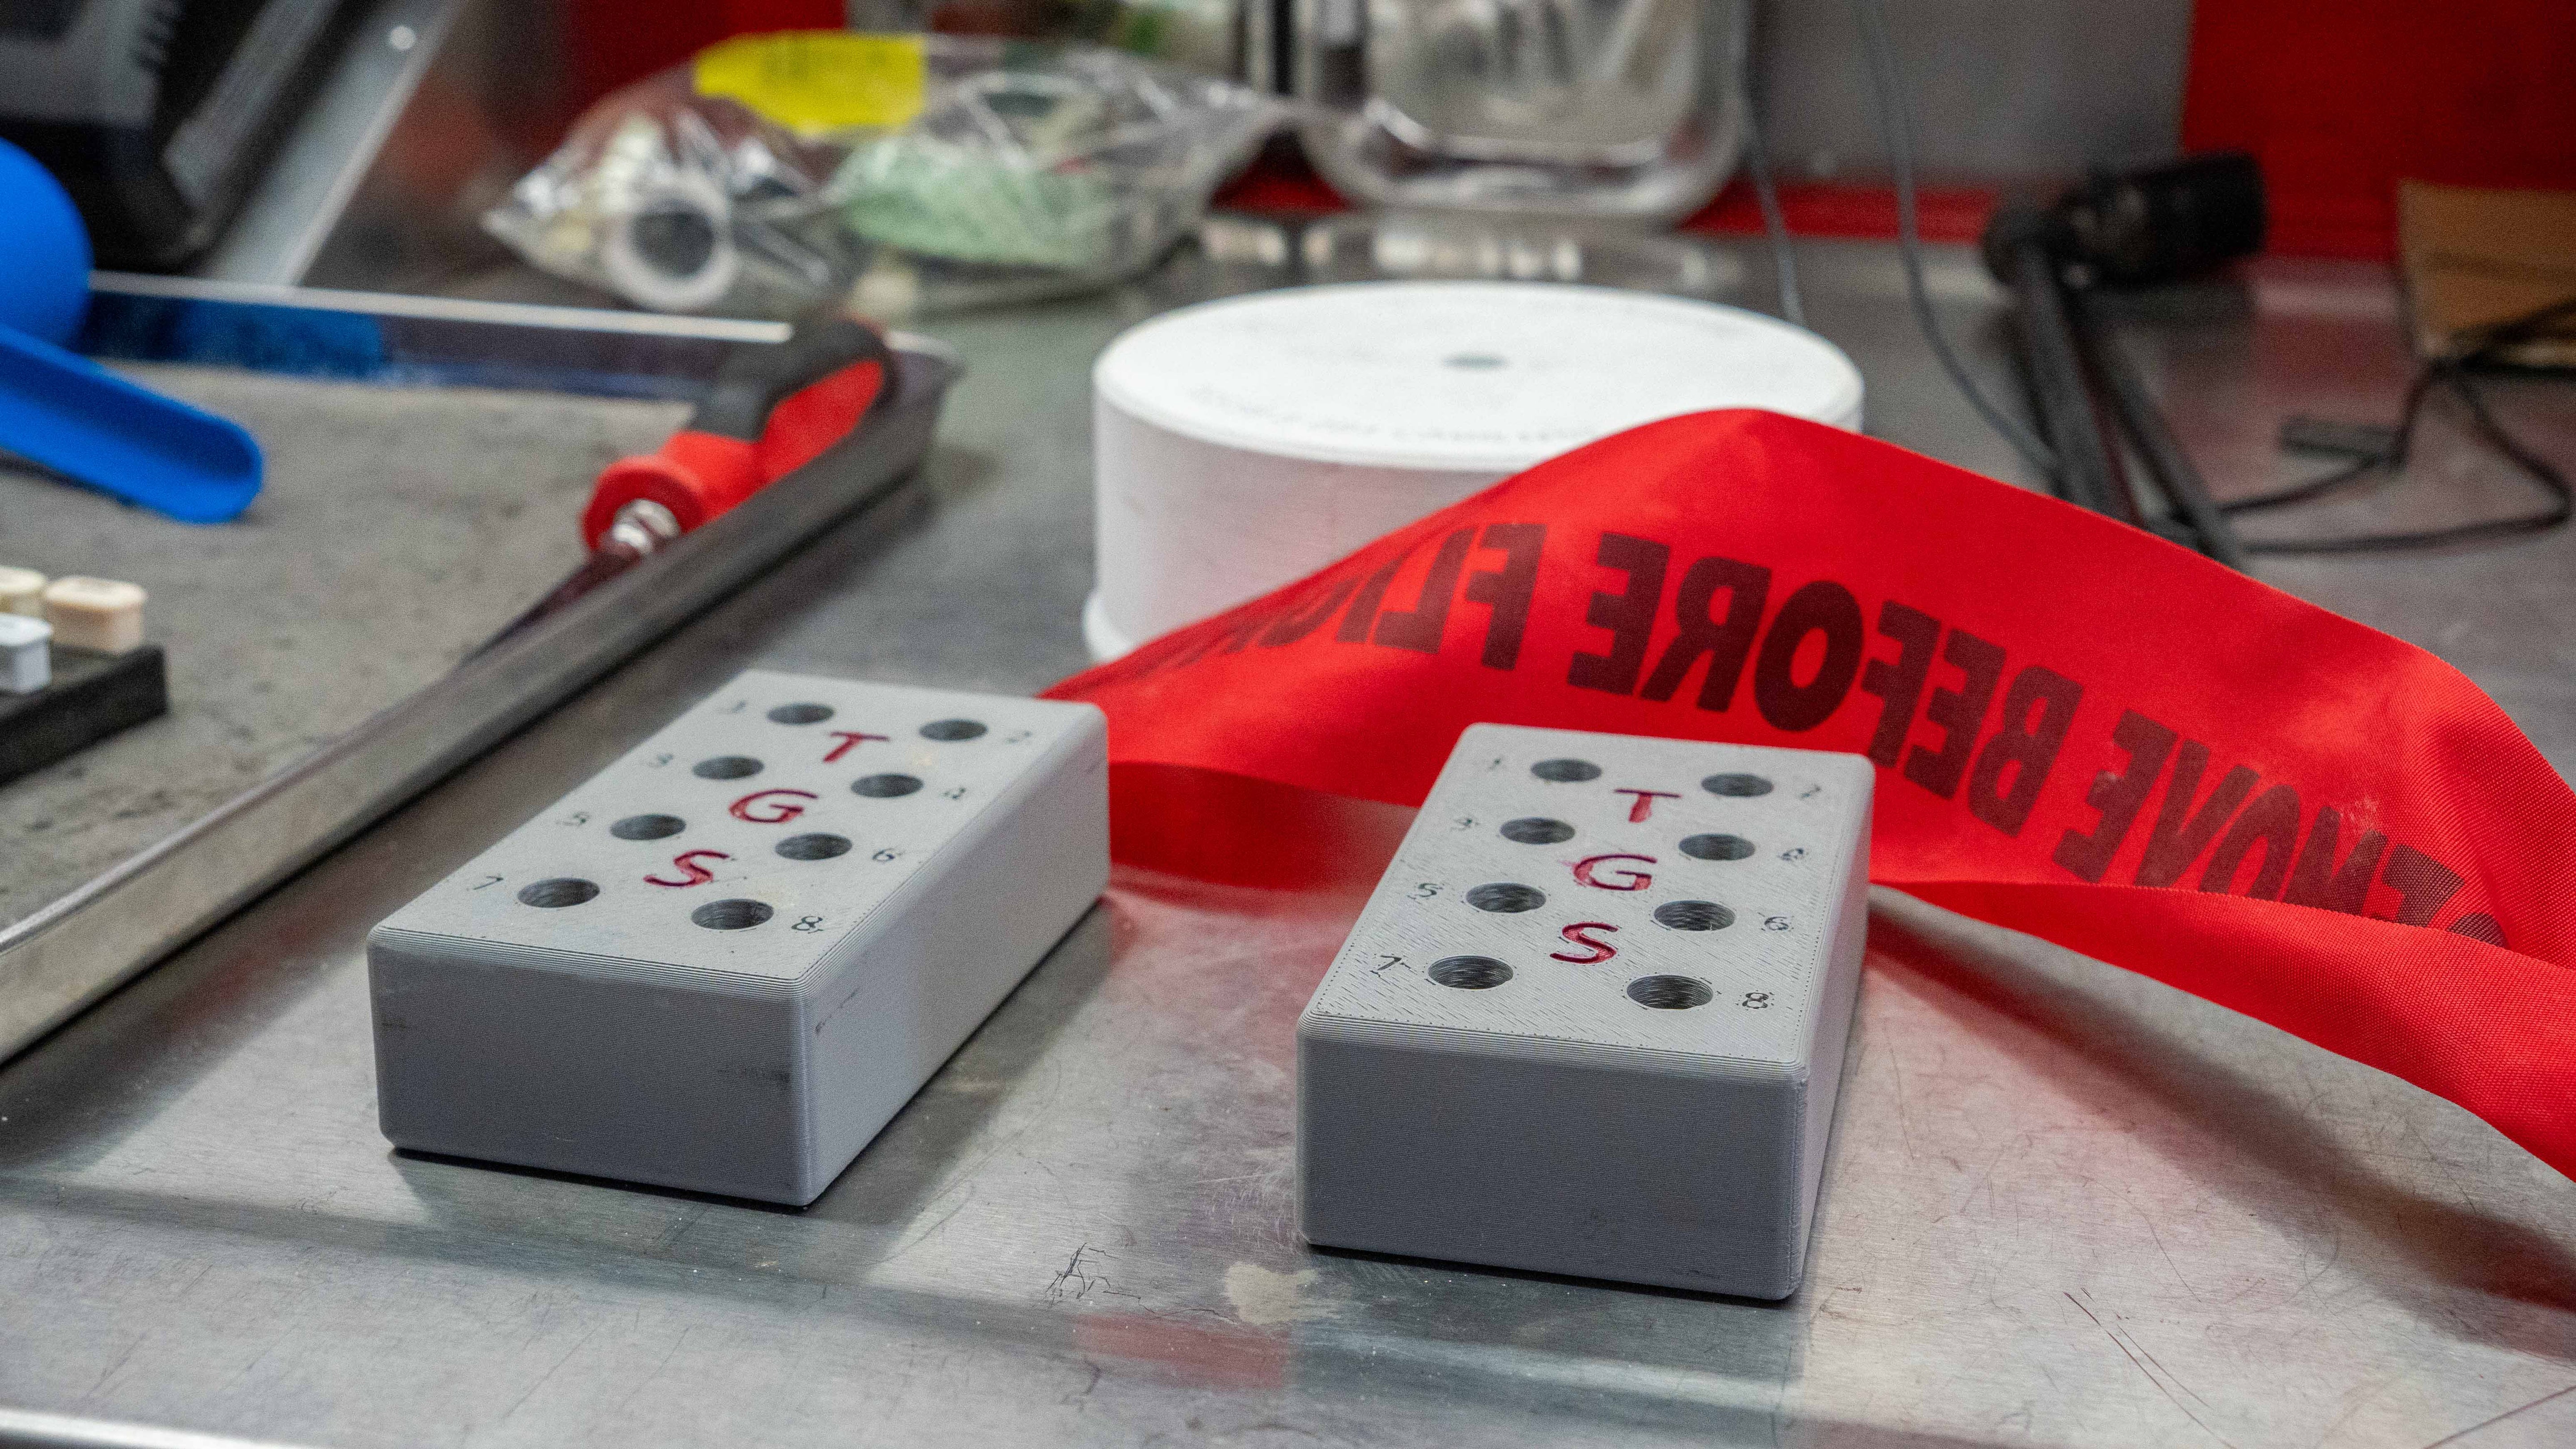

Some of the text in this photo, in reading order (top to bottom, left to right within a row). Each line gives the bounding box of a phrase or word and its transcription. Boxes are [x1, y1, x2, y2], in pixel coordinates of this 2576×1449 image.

[822, 731, 890, 763] T
[729, 788, 818, 824] G
[1613, 788, 1682, 823] T
[872, 848, 896, 862] 6
[643, 849, 730, 887] S
[1572, 854, 1657, 891] G
[472, 874, 504, 891] 7
[791, 915, 824, 932] 8
[1764, 916, 1790, 931] 6
[1550, 921, 1618, 964] S
[1377, 954, 1403, 972] 7
[1741, 991, 1770, 1009] 8
